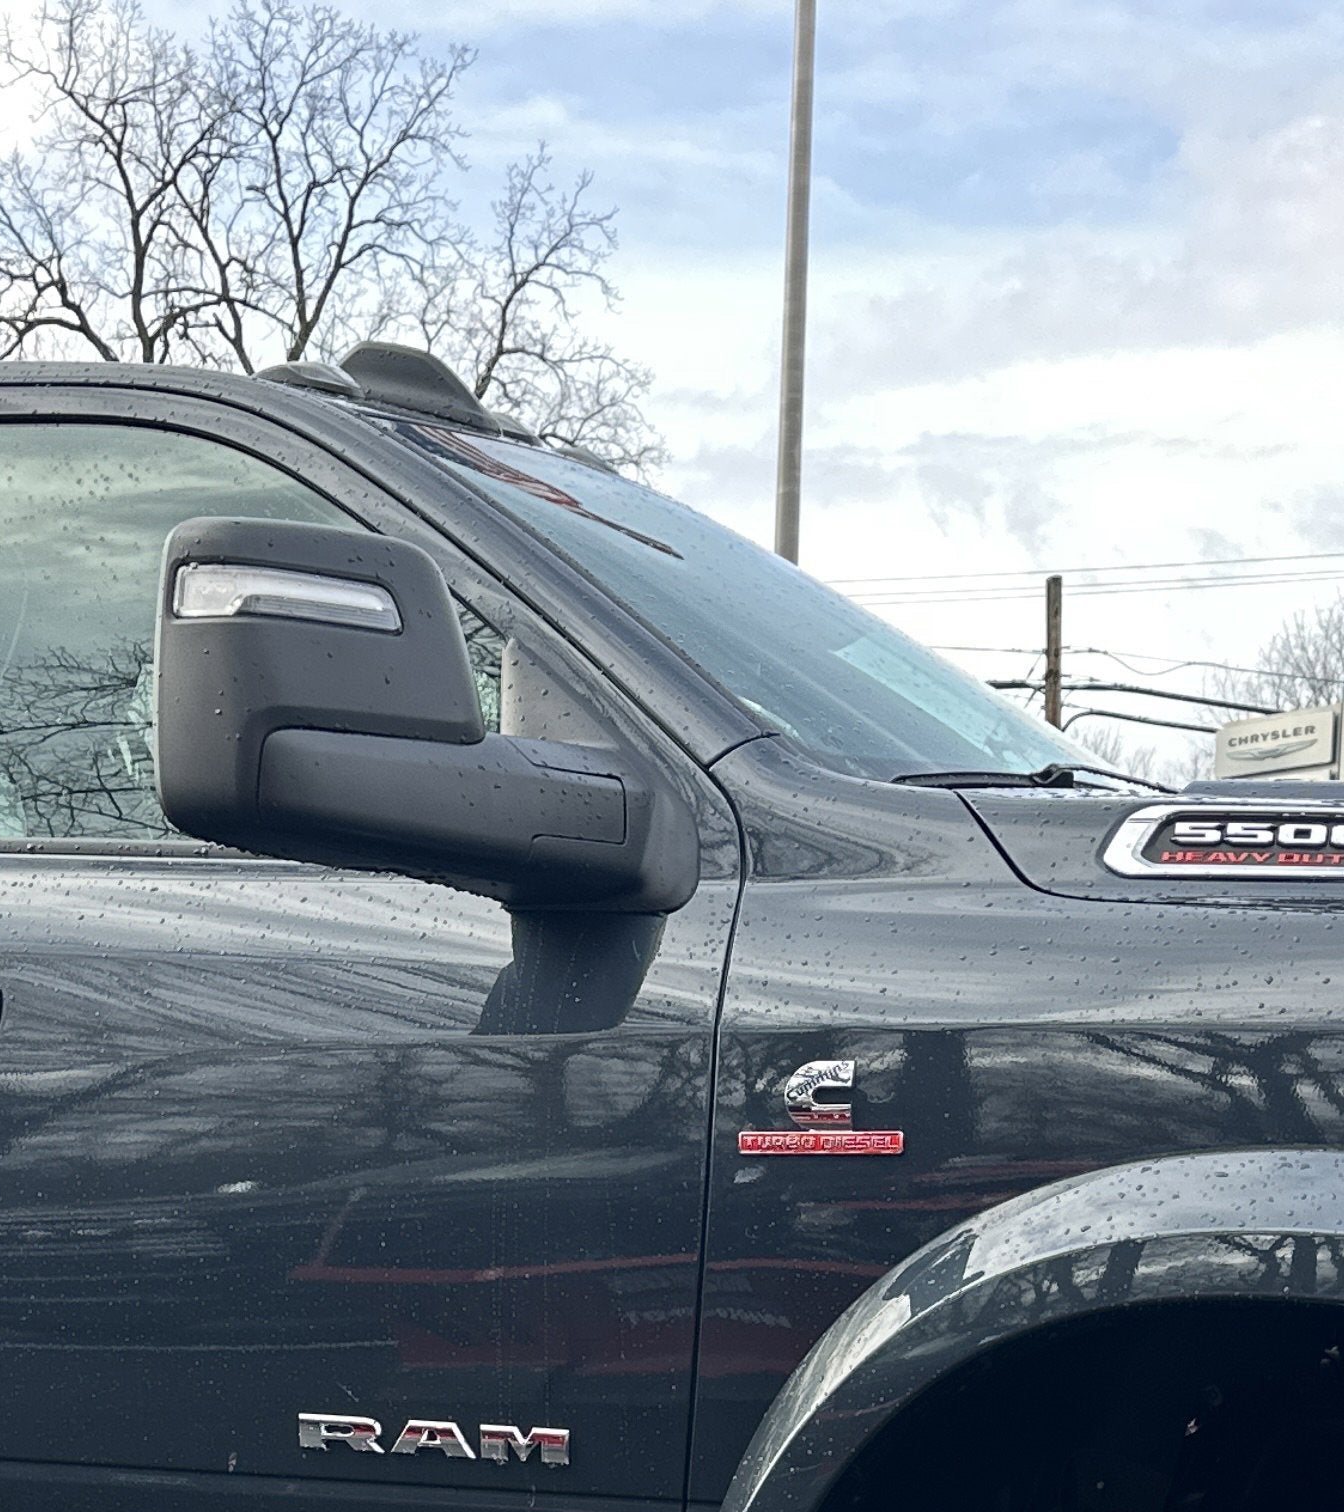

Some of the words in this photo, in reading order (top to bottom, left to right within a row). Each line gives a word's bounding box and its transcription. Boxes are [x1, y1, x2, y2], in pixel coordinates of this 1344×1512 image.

[1227, 725, 1317, 748] CHRYSLER
[1160, 850, 1273, 864] HEAVY
[786, 1060, 851, 1102] Cummins
[742, 1134, 817, 1150] TURBO
[819, 1134, 901, 1150] DIESEL
[297, 1412, 570, 1467] RAM
